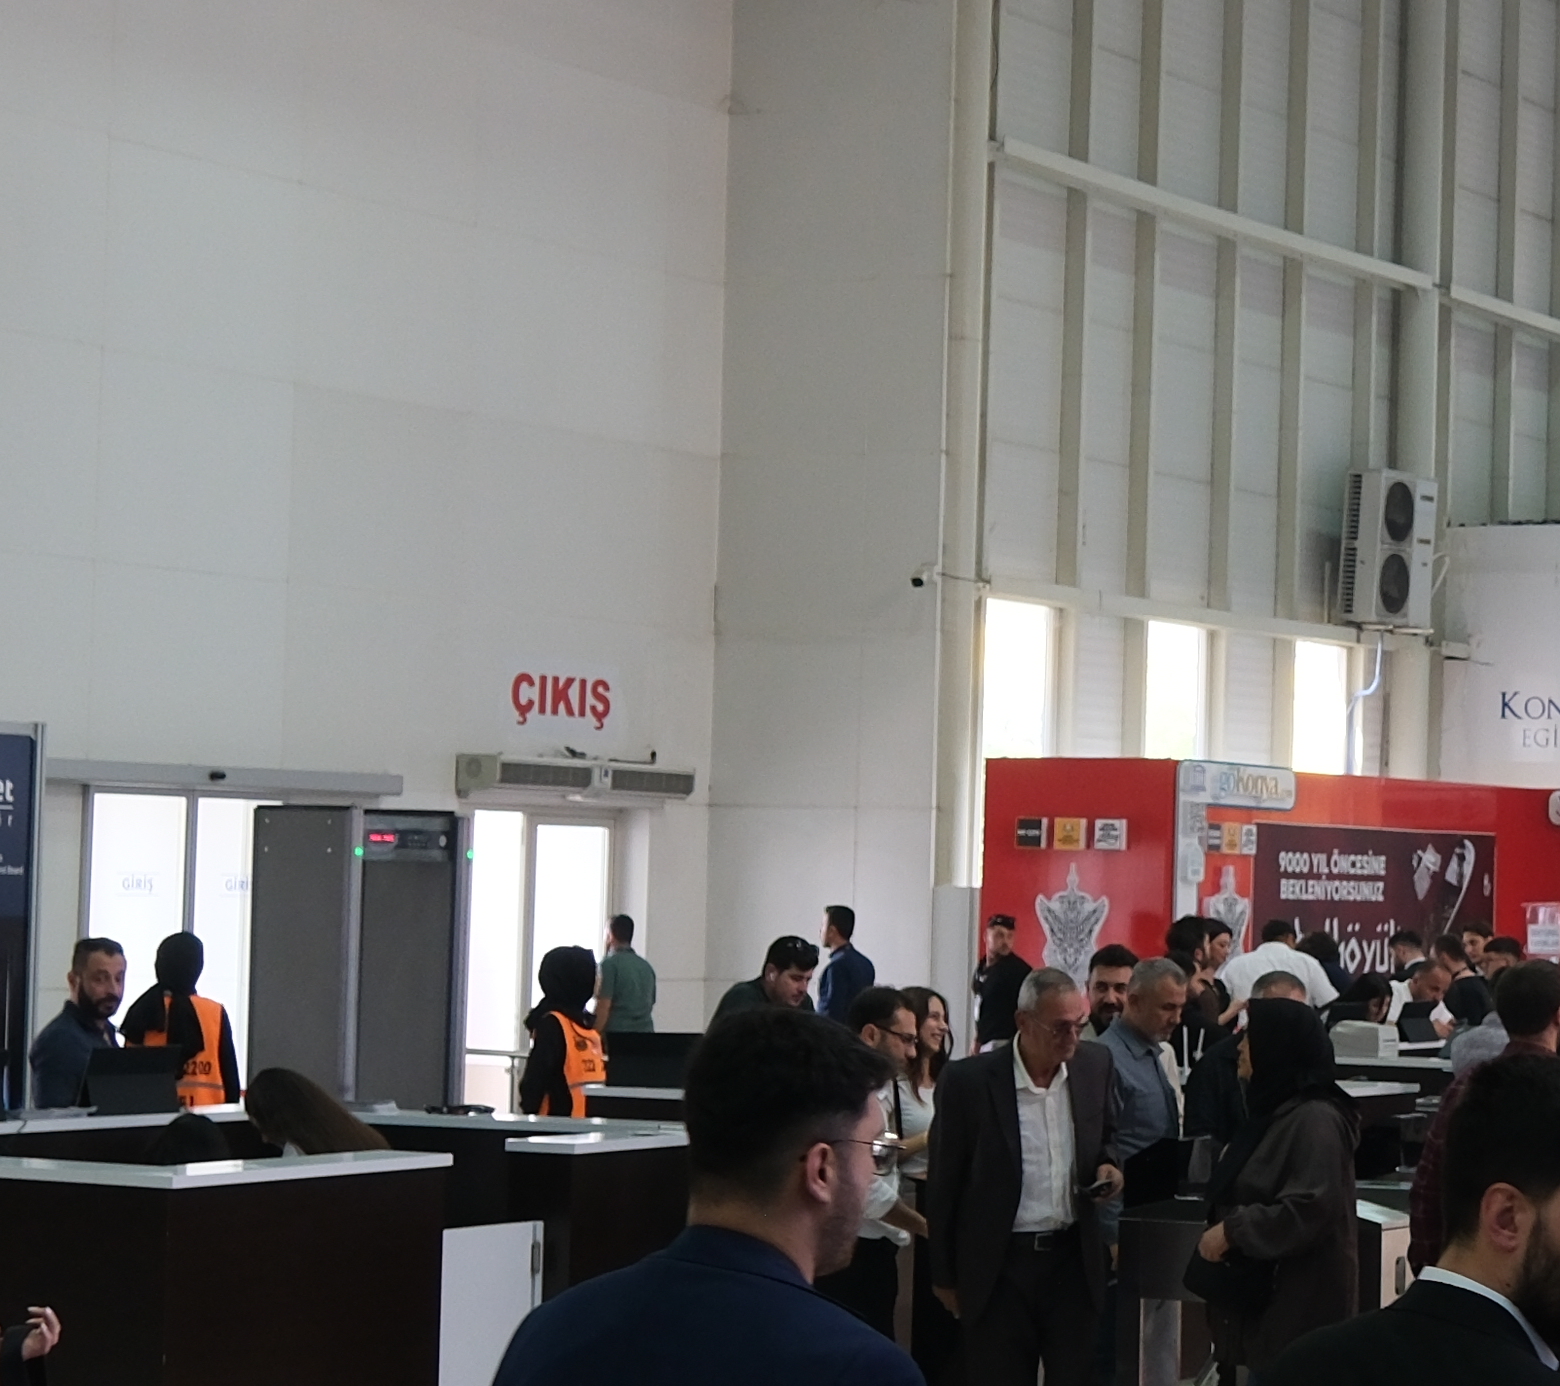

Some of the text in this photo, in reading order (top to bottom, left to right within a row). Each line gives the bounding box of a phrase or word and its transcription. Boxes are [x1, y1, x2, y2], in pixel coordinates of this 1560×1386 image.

[511, 672, 611, 731] ÇIKIŞ
[1279, 851, 1309, 873] 9000
[225, 875, 250, 893] GİRİ
